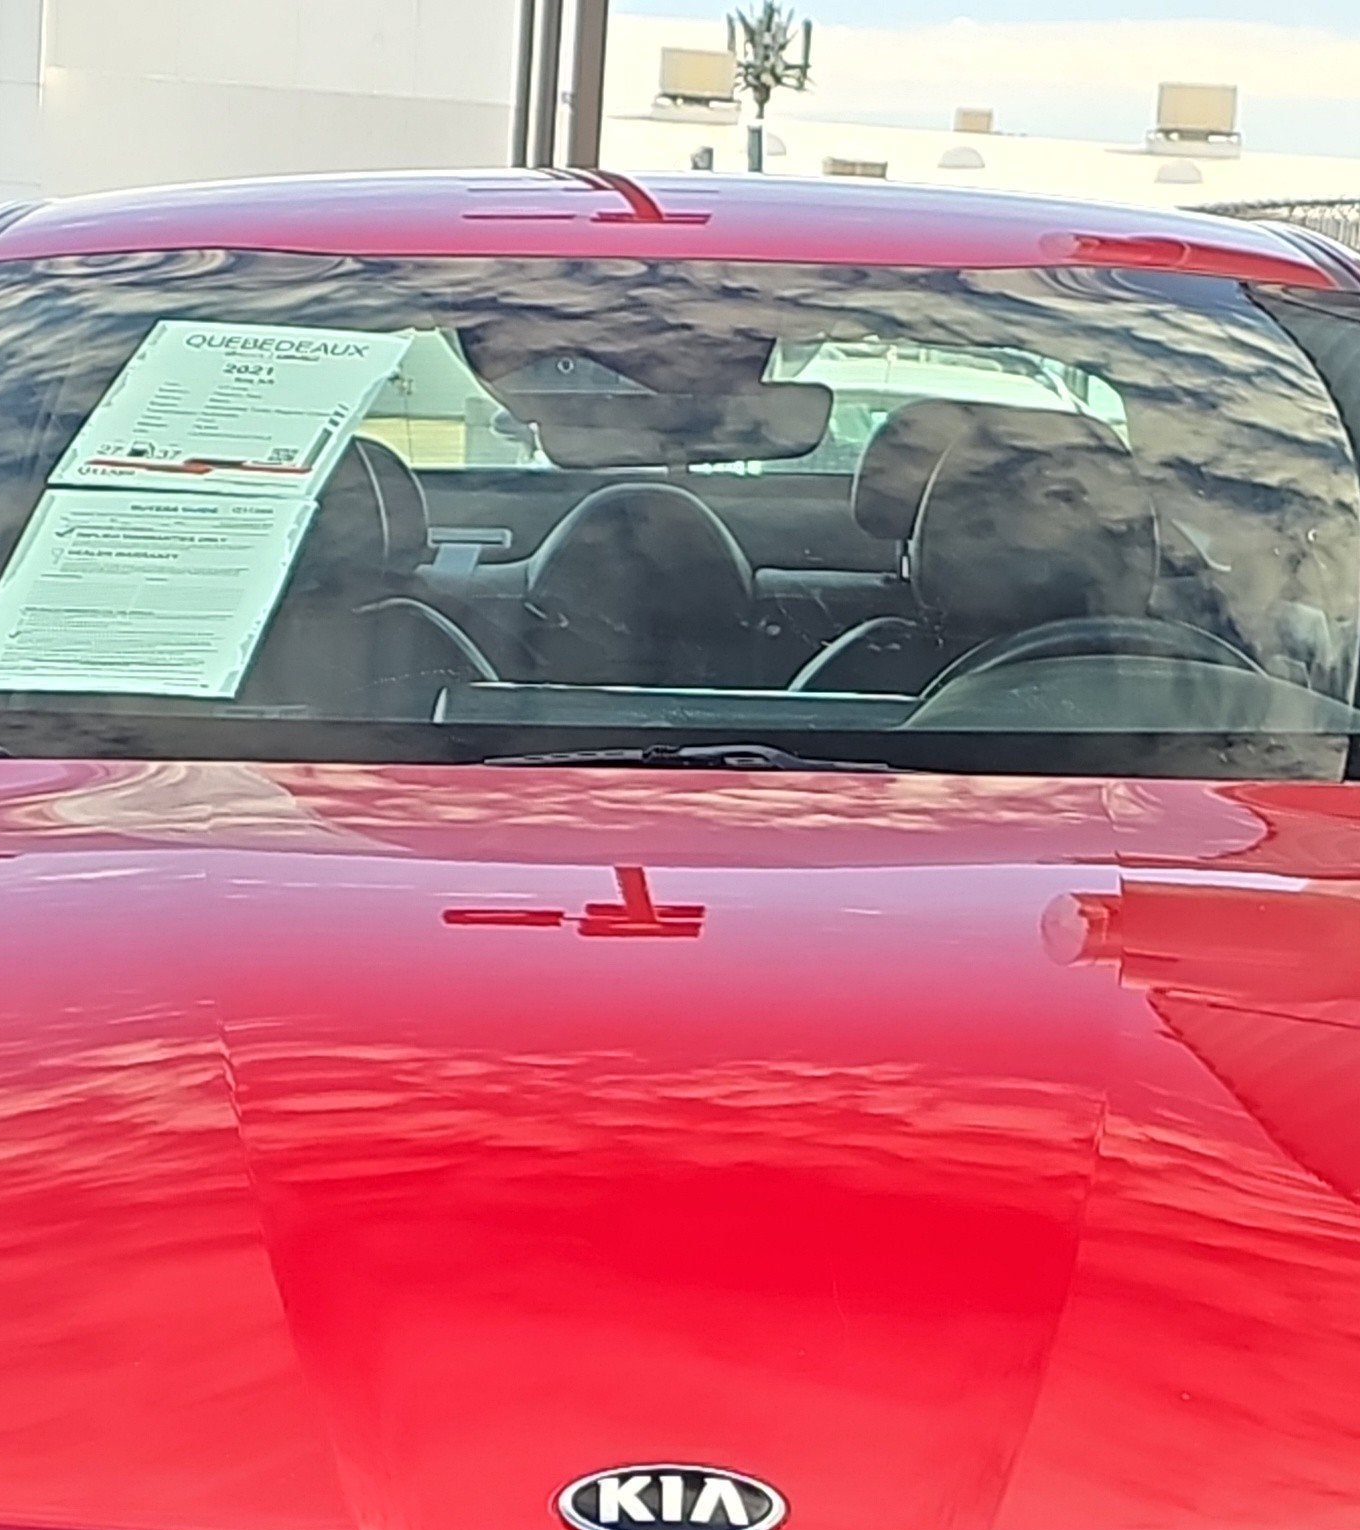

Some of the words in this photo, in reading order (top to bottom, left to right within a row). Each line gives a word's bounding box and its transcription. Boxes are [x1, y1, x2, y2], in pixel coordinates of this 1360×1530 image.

[186, 334, 369, 357] QUEBEDEAUX
[223, 362, 274, 376] 2021
[596, 1474, 750, 1526] KIA
